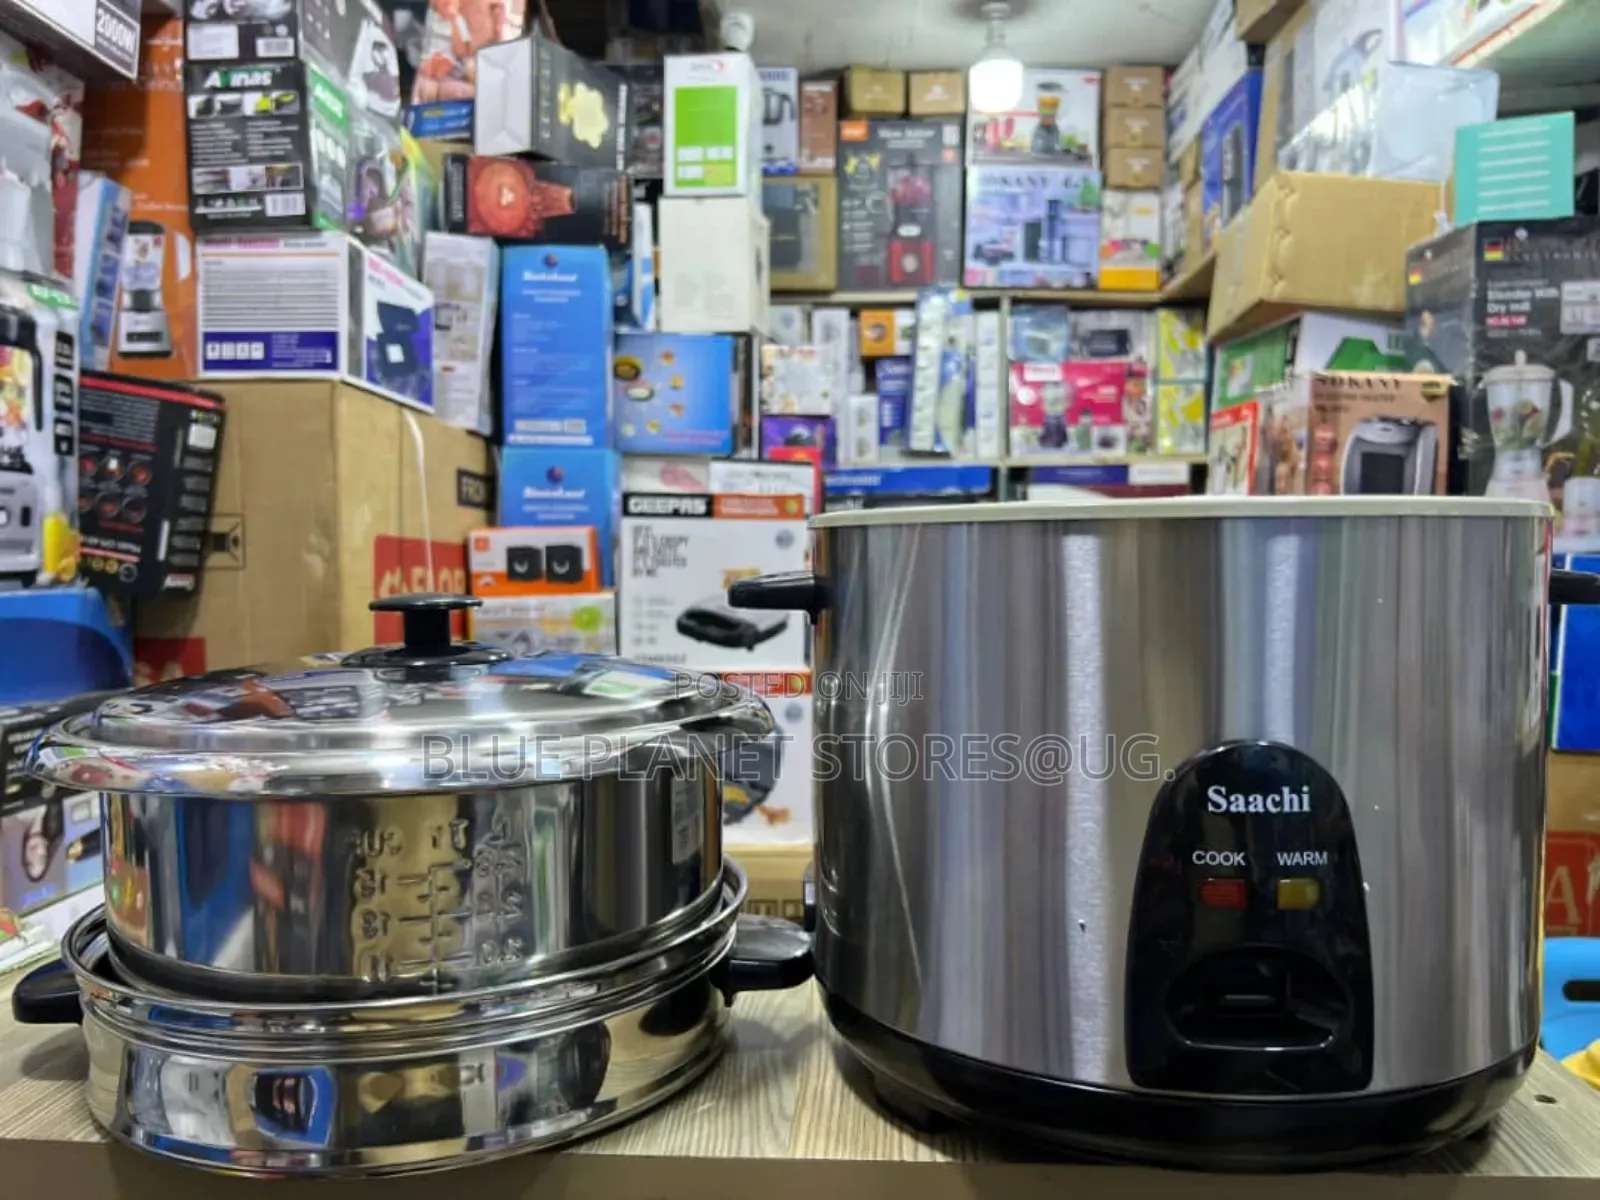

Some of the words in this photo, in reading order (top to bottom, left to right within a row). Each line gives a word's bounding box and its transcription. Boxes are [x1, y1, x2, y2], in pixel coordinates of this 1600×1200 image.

[628, 497, 708, 515] GEEPAS
[1206, 784, 1312, 814] Saachi
[1192, 851, 1247, 867] COOK
[1276, 851, 1329, 867] WARM
